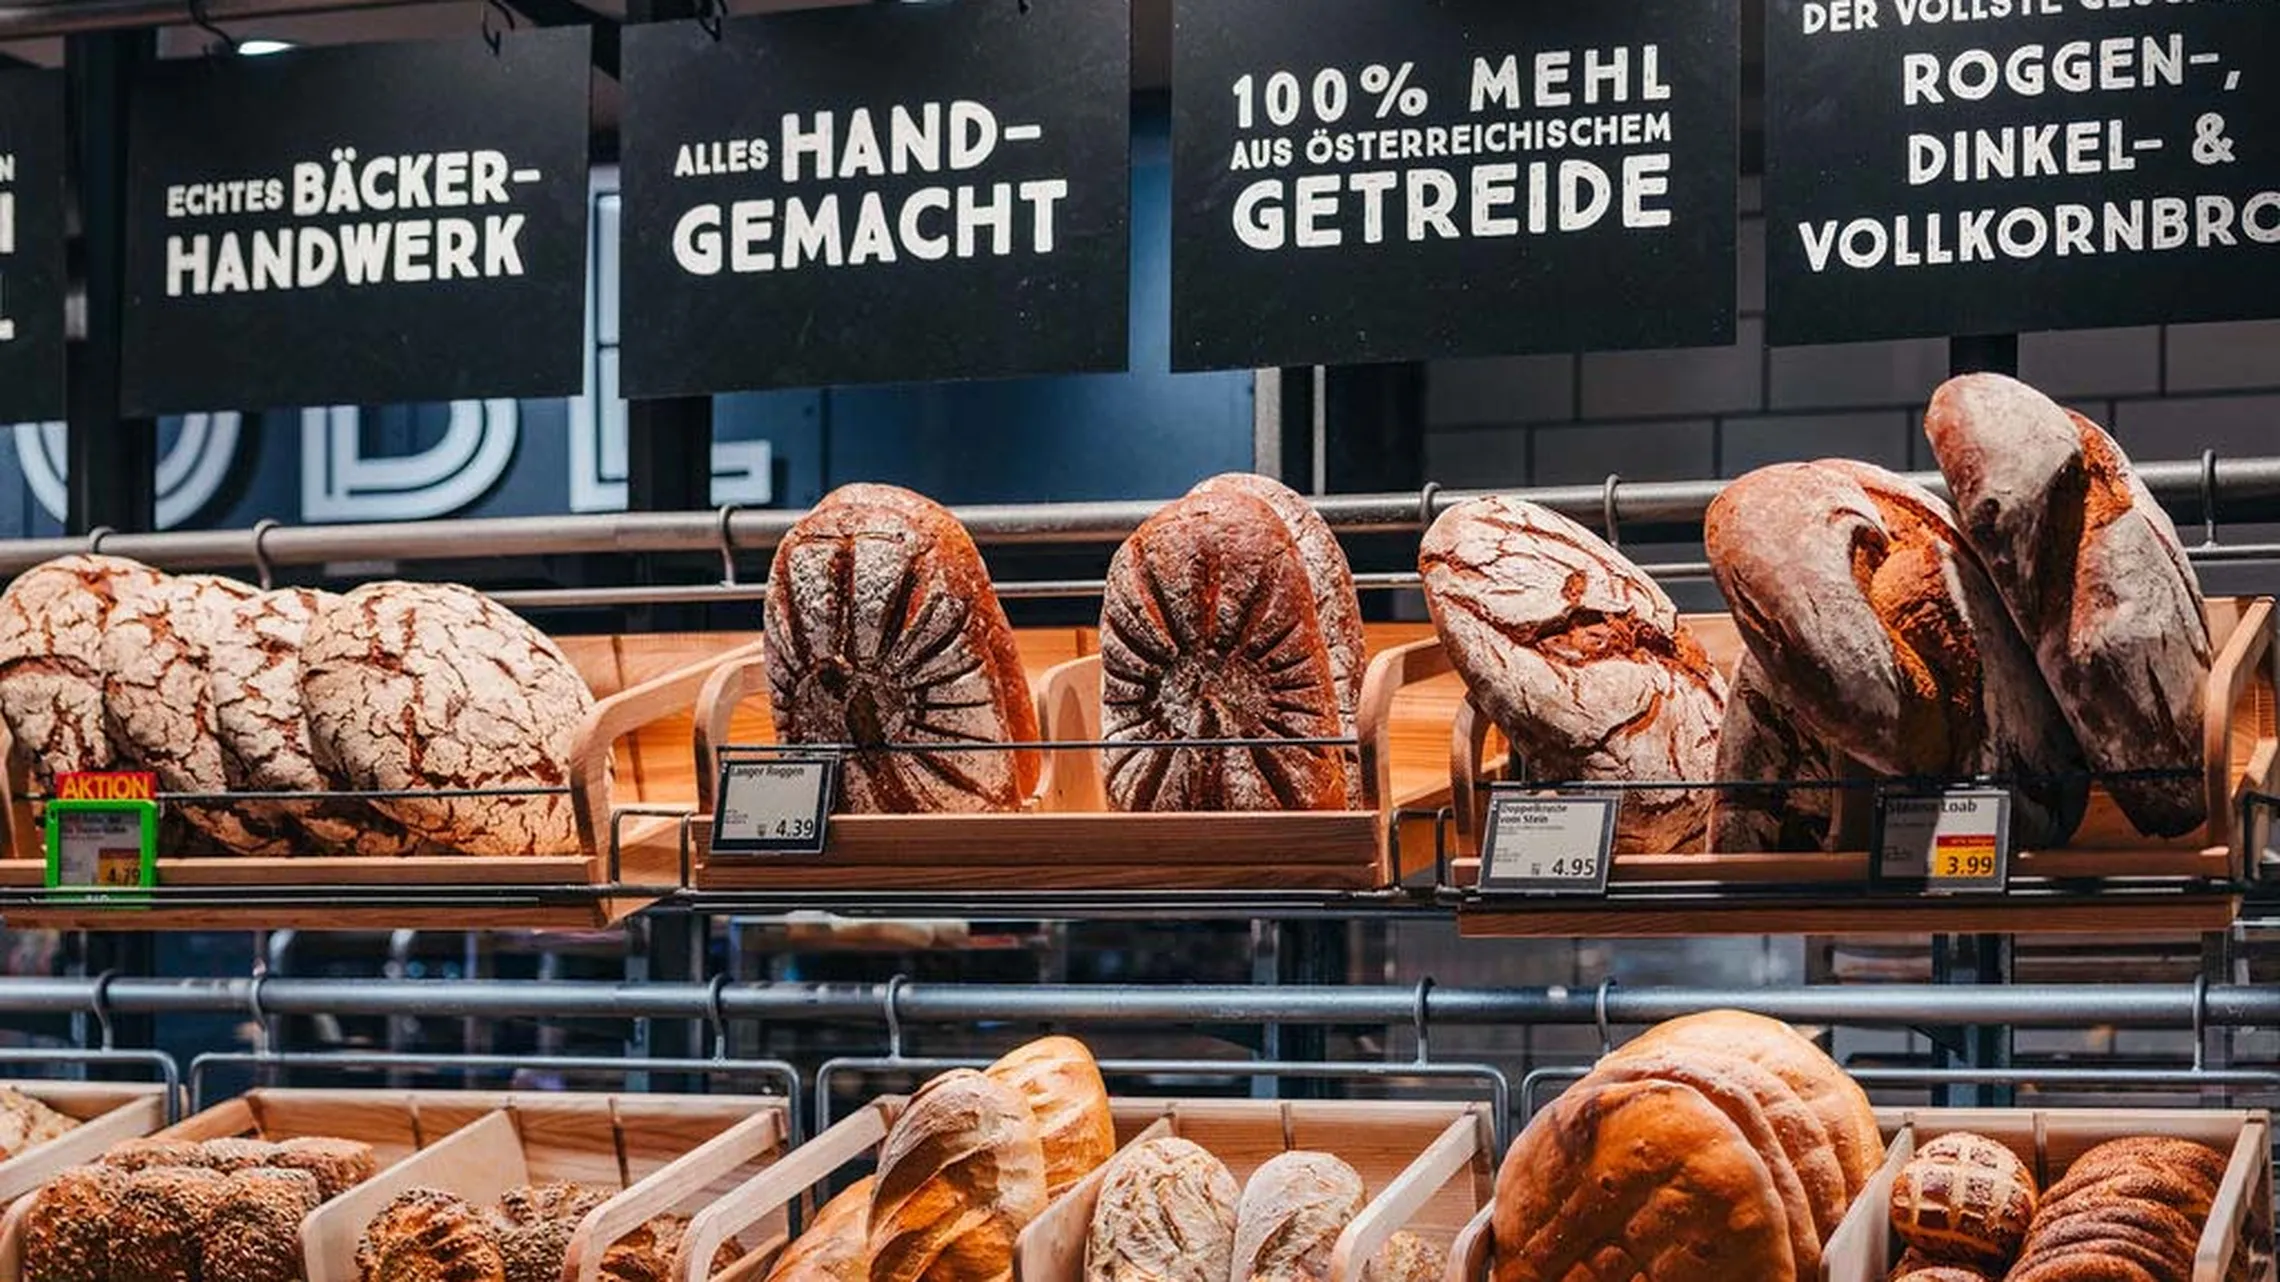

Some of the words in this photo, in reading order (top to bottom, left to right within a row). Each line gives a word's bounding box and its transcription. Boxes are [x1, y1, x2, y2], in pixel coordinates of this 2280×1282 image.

[1803, 0, 1879, 34] DER
[1232, 62, 1428, 128] 100%
[1470, 45, 1671, 112] MEHL
[1904, 34, 2241, 105] ROGGEN-,
[674, 139, 769, 177] ALLES
[781, 101, 1042, 183] HAND-
[1230, 138, 1293, 171] AUS
[1306, 112, 1672, 164] ÖSTERREICHISCHEM
[1908, 119, 2163, 185] DINKEL-
[2192, 112, 2236, 165] &
[167, 179, 284, 218] ECHTES
[293, 147, 541, 217] BÄCKER-
[1231, 153, 1672, 250] GETREIDE
[167, 214, 525, 297] HANDWERK
[673, 179, 1068, 275] GEMACHT
[62, 776, 150, 799] AKTION
[1522, 813, 1549, 824] Stein
[1940, 800, 1978, 812] Loab
[776, 818, 814, 837] 4.39
[1552, 858, 1595, 876] 4.95
[1946, 856, 1993, 875] 3.99
